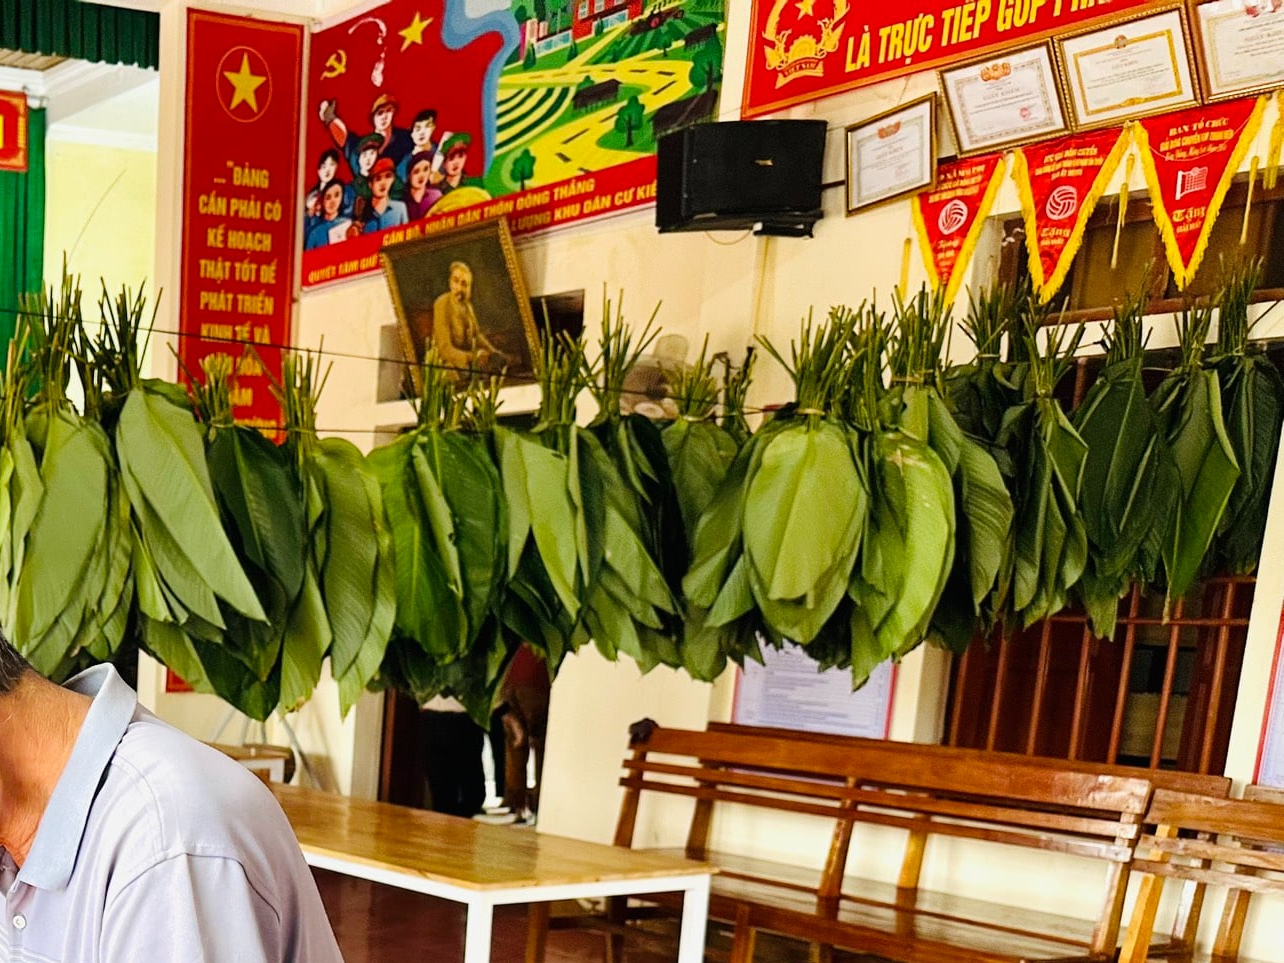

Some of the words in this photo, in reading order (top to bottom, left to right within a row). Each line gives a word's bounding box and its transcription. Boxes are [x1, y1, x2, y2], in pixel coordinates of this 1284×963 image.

[845, 25, 871, 73] LÀ
[879, 13, 935, 65] TRỰC
[554, 203, 581, 221] KHU
[227, 229, 272, 255] HOẠCH
[200, 290, 234, 312] PHÁT
